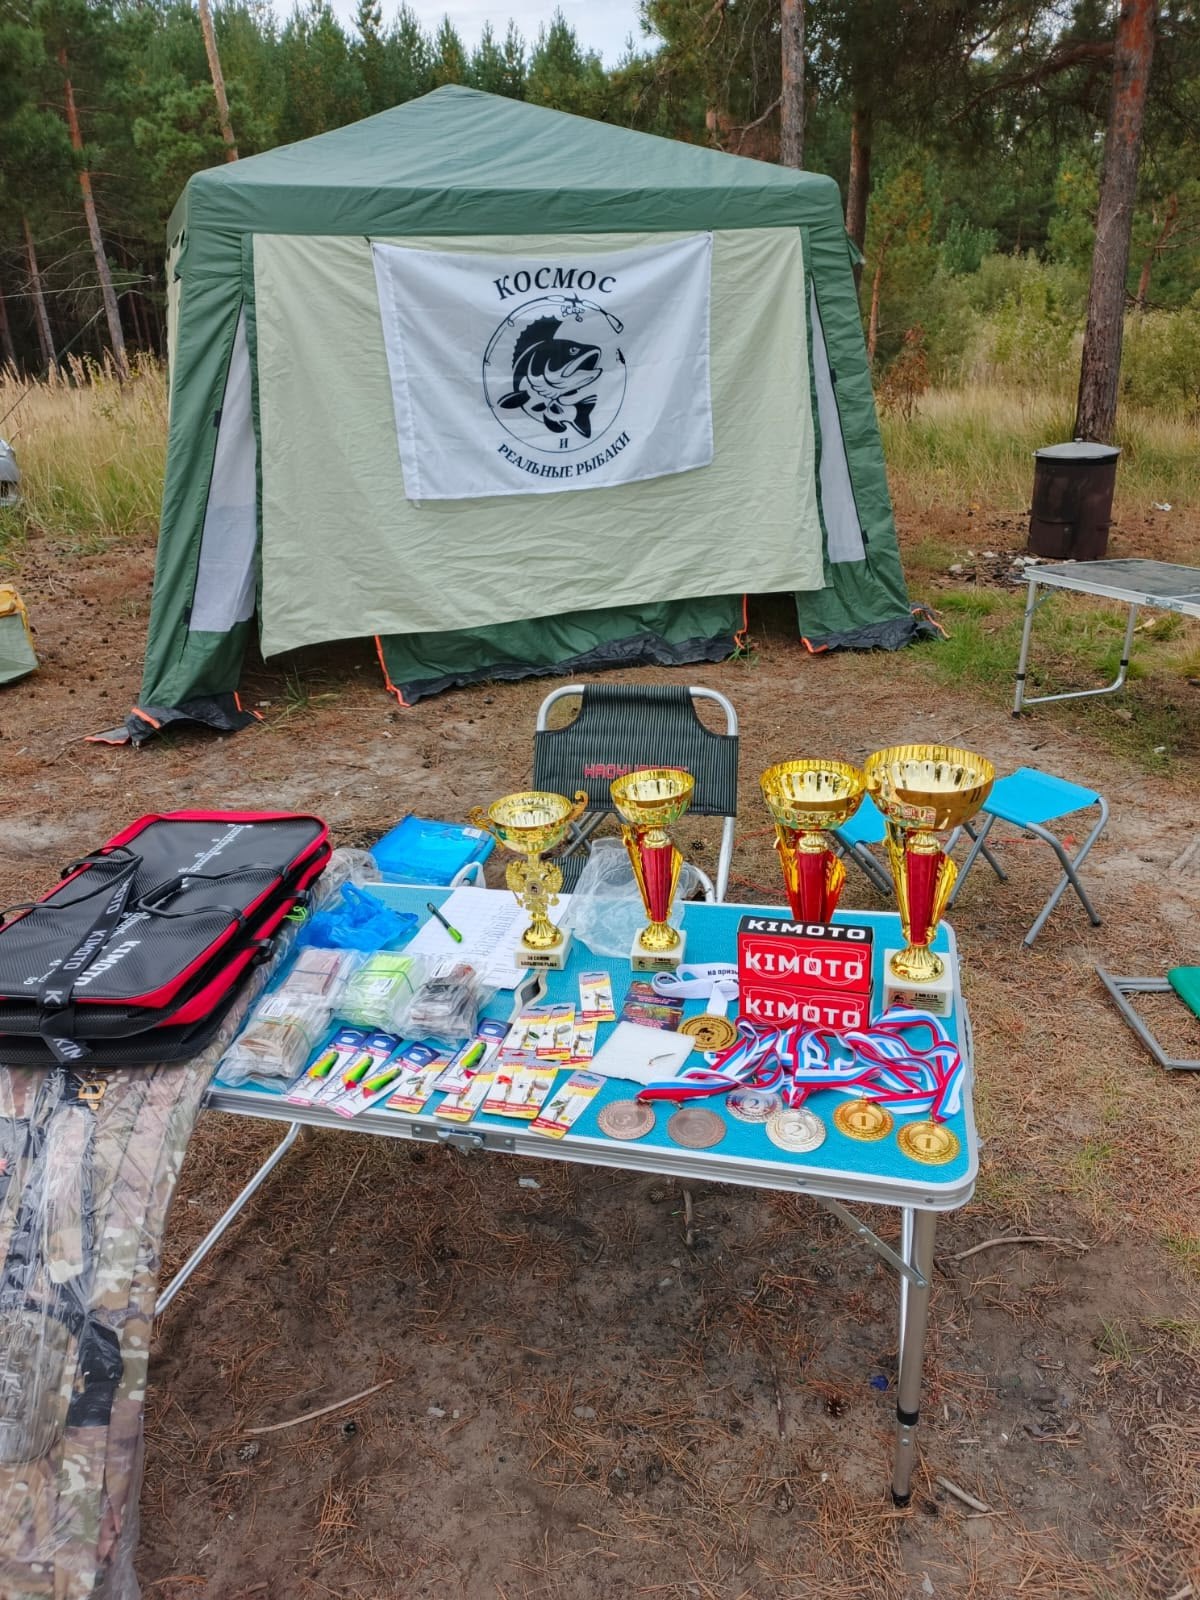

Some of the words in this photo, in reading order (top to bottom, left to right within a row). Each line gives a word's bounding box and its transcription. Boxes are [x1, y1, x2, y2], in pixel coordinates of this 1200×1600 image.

[493, 267, 616, 300] КОСМОС
[559, 437, 569, 449] И
[497, 443, 573, 479] РЕАЛЬНЫЕ
[576, 431, 632, 476] РЫБАКИ
[747, 919, 866, 940] KIMOTO
[63, 929, 108, 971] KIMOTO
[745, 951, 863, 980] KIMOTO
[745, 996, 861, 1029] KIMOTO
[749, 1099, 760, 1110] 2
[791, 1125, 802, 1137] 2
[861, 1115, 867, 1126] 1
[925, 1137, 931, 1149] 1
